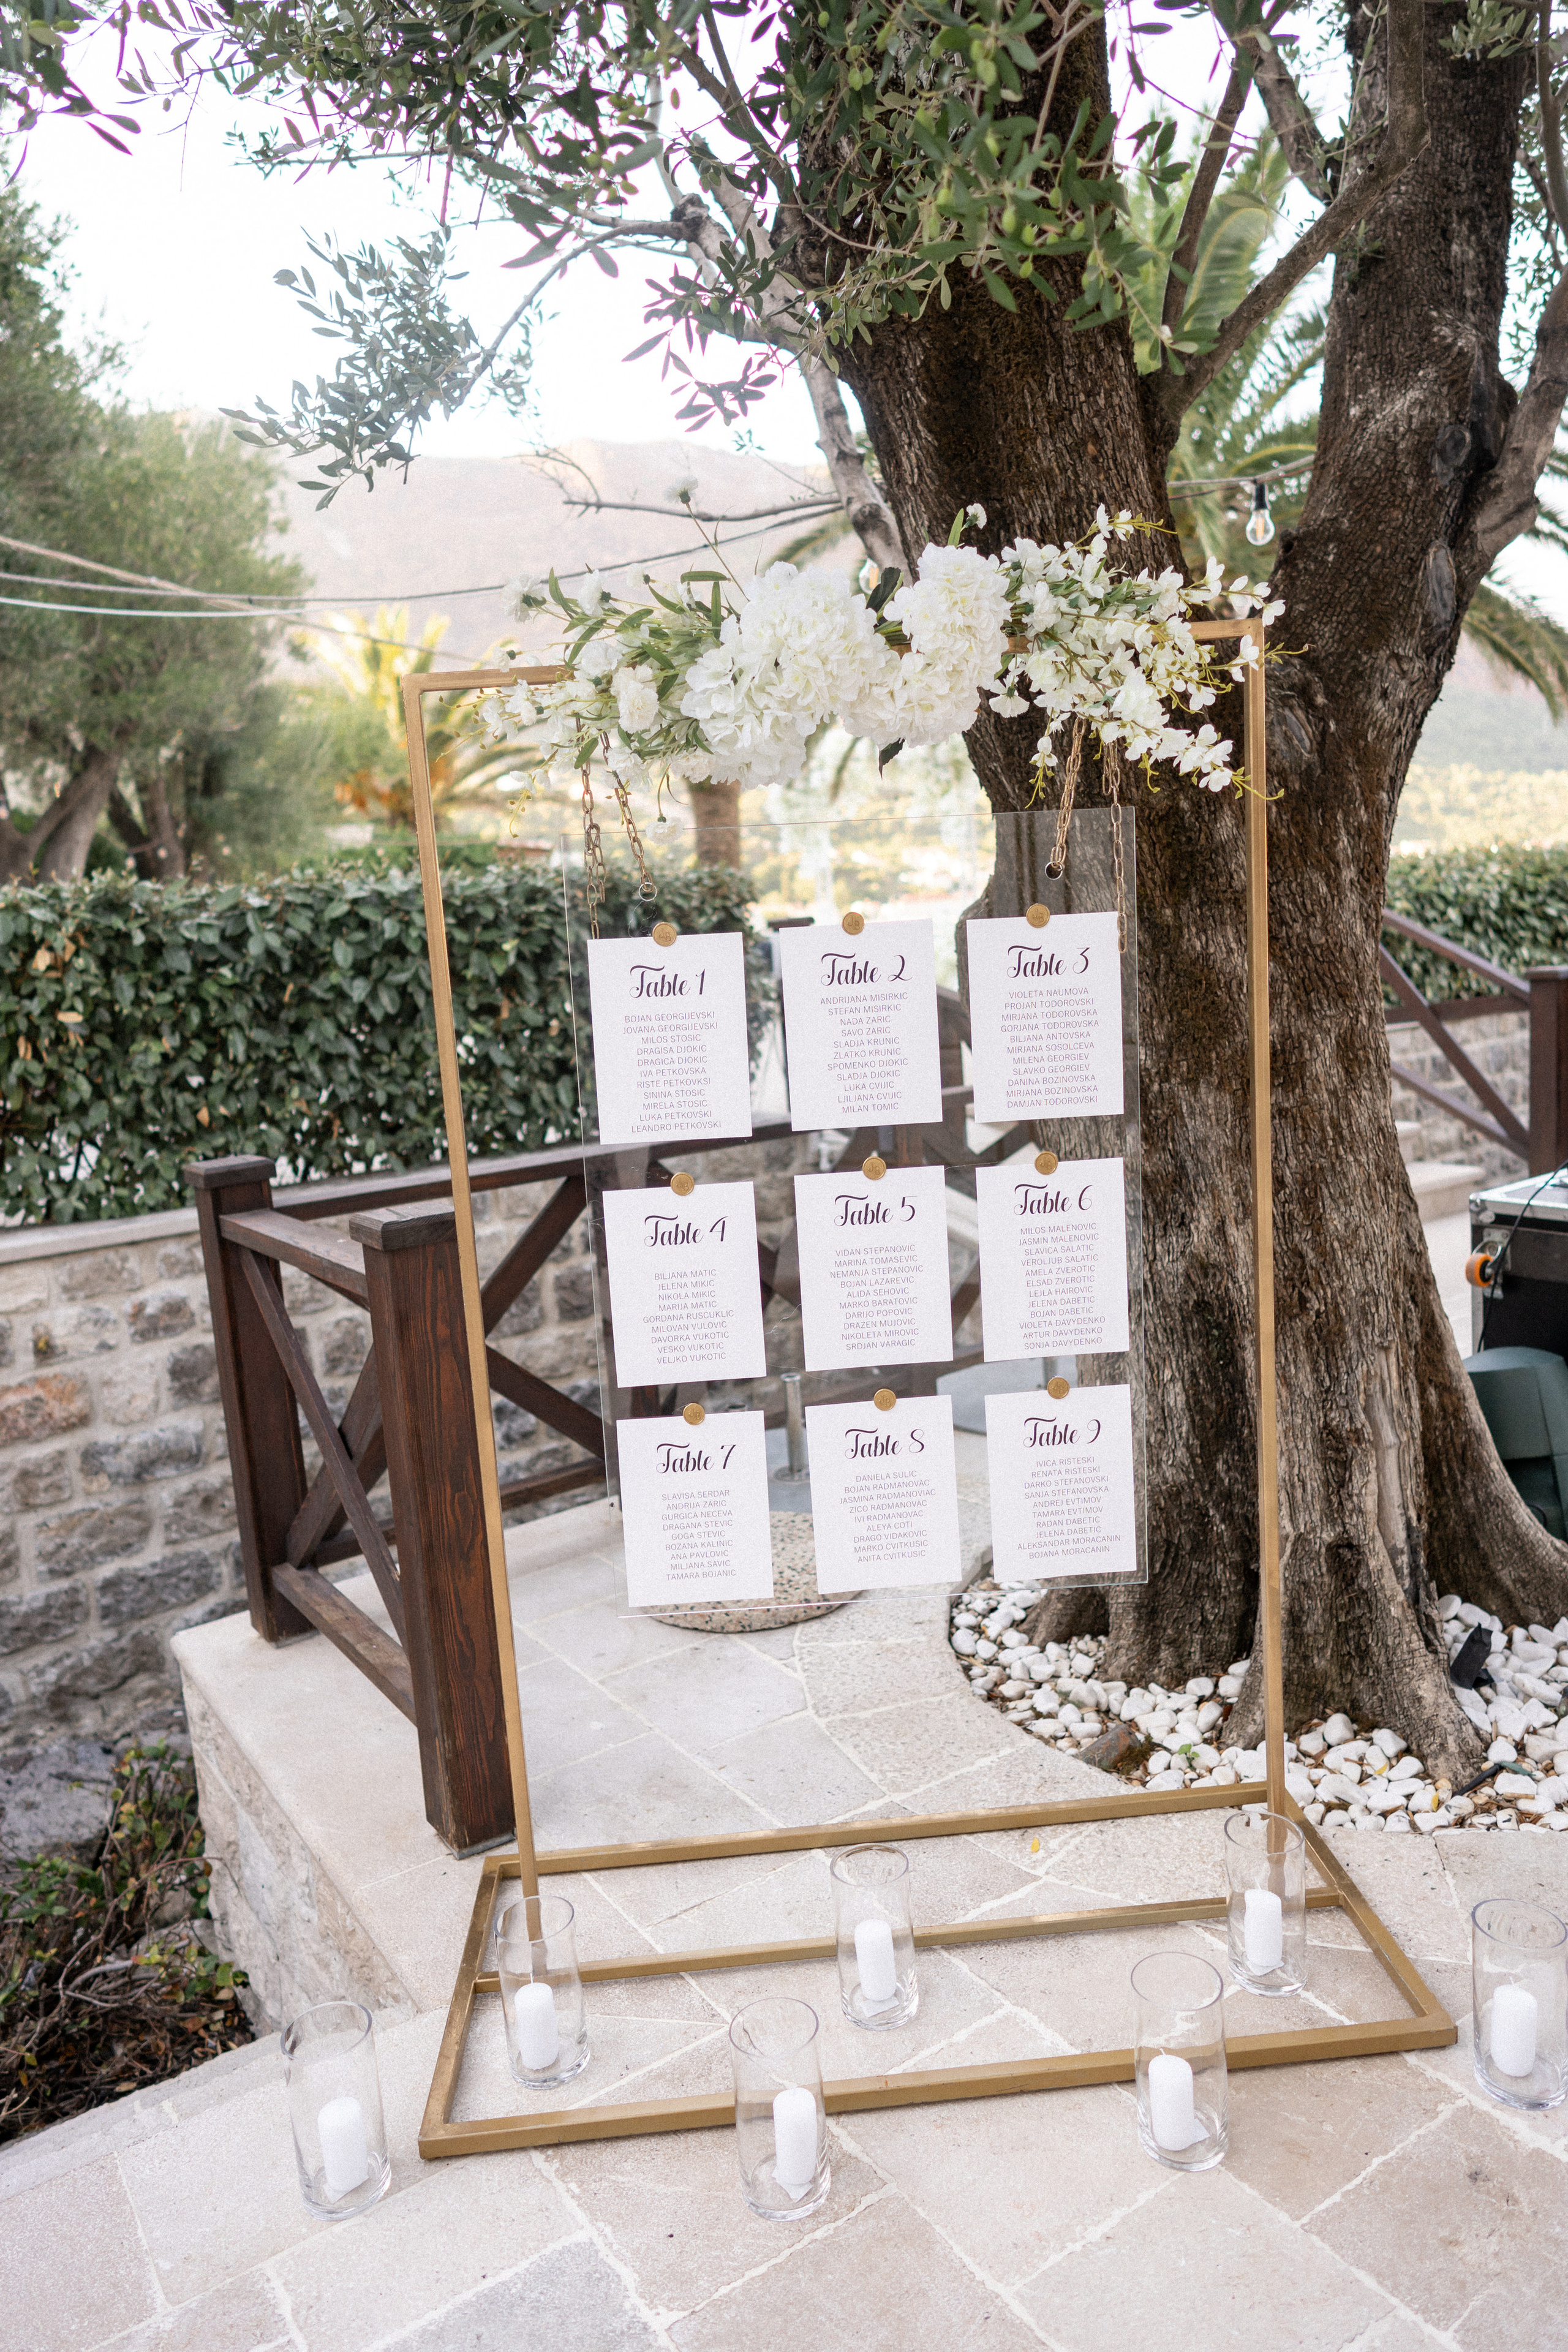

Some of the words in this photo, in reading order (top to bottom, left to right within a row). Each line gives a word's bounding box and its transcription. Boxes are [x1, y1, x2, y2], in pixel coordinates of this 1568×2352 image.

[1007, 946, 1066, 978] Table
[1073, 948, 1090, 973] 3
[821, 953, 881, 986] Table
[888, 956, 912, 981] 2
[630, 965, 690, 998] Table
[696, 969, 704, 994] 1
[820, 995, 867, 1005] ANDRIJANA
[870, 992, 908, 1001] MISIRKIC
[1008, 990, 1044, 998] VIOLETA
[1046, 987, 1088, 996] NAUMOVA
[827, 1006, 860, 1016] STEFAN
[863, 1003, 901, 1012] MISIRKIC
[1005, 1001, 1036, 1010] PROJAN
[1039, 998, 1093, 1008] TODOROVSKI
[624, 1014, 652, 1023] BOJAN
[654, 1011, 714, 1021] GEORGIJEVSKI
[840, 1017, 863, 1025] NADA
[865, 1015, 891, 1024] ZARIC
[623, 1025, 655, 1034] JOVANA
[657, 1022, 717, 1032] GEORGIJEVSKI
[841, 1028, 863, 1036] SAVO
[865, 1026, 890, 1035] ZARIC
[1000, 1023, 1039, 1032] GORJANA
[1041, 1019, 1099, 1029] TODOROVSKA
[636, 1046, 674, 1055] DRAGISA
[676, 1044, 706, 1053] DJOKIC
[637, 1057, 674, 1066] DRAGICA
[677, 1055, 707, 1064] DJOKIC
[1012, 1055, 1044, 1064] MILENA
[1047, 1052, 1089, 1062] GEORGIEV
[827, 1060, 875, 1071] SPOMENKO
[878, 1058, 908, 1067] DJOKIC
[1012, 1066, 1046, 1075] SLAVKO
[1047, 1063, 1090, 1073] GEORGIEV
[837, 1072, 867, 1081] SLADJA
[870, 1069, 900, 1079] DJOKIC
[1008, 1077, 1039, 1087] DANINA
[1042, 1074, 1095, 1084] BOZINOVSKA
[663, 1077, 710, 1087] PETKOVKSI
[643, 1090, 672, 1099] SININA
[674, 1088, 705, 1097] STOSIC
[837, 1093, 874, 1102] LJILJANA
[876, 1091, 902, 1099] CVIJIC
[1006, 1088, 1042, 1097] MIRJANA
[1044, 1085, 1098, 1095] BOZINOVSKA
[643, 1101, 674, 1110] MIRELA
[677, 1099, 707, 1108] STOSIC
[842, 1104, 869, 1113] MILAN
[871, 1102, 899, 1111] TOMIC
[1007, 1099, 1041, 1108] DAMJAN
[1044, 1095, 1097, 1106] TODOROVSKI
[639, 1113, 662, 1121] LUKA
[665, 1110, 712, 1120] PETKOVSKI
[1014, 1184, 1071, 1215] Table
[1079, 1185, 1092, 1210] 6
[835, 1195, 893, 1226] Table
[900, 1196, 916, 1221] 5
[644, 1215, 703, 1246] Table
[710, 1216, 728, 1242] 4
[1020, 1226, 1046, 1235] MILOS
[1048, 1222, 1096, 1232] MALENOVIC
[1024, 1246, 1058, 1256] SLAVICA
[1060, 1243, 1093, 1253] SALATIC
[654, 1271, 688, 1280] BILJANA
[690, 1268, 716, 1277] MATIC
[658, 1281, 688, 1291] JELENA
[690, 1279, 714, 1287] MIKIC
[840, 1279, 866, 1288] BOJAN
[869, 1276, 914, 1286] LAZAREVIC
[658, 1292, 689, 1300] NIKOLA
[846, 1289, 870, 1298] ALIDA
[873, 1287, 909, 1296] SEHOVIC
[1029, 1289, 1052, 1297] LEJLA
[1055, 1285, 1093, 1295] HAIROVIC
[658, 1302, 688, 1311] MARIJA
[839, 1300, 869, 1309] MARKO
[872, 1297, 918, 1306] BARATOVIC
[1028, 1298, 1057, 1308] JELENA
[1060, 1295, 1095, 1305] DABETIC
[845, 1310, 874, 1319] DARIJO
[876, 1307, 913, 1316] POPOVIC
[1030, 1310, 1055, 1318] BOJAN
[1058, 1306, 1093, 1316] DABETIC
[652, 1324, 688, 1333] MILOVAN
[691, 1321, 726, 1330] VULOVIC
[843, 1321, 876, 1330] DRAZEN
[879, 1317, 915, 1327] MUJOVIC
[1019, 1320, 1052, 1329] VIOLETA
[1055, 1316, 1105, 1326] DAVYDENKO
[650, 1333, 690, 1344] DAVORKA
[692, 1330, 729, 1340] VUKOTIC
[841, 1331, 881, 1340] NIKOLETA
[884, 1327, 919, 1336] MIROVIC
[1022, 1330, 1050, 1339] ARTUR
[1052, 1326, 1102, 1336] DAVYDENKO
[846, 1341, 877, 1351] SRDJAN
[880, 1338, 915, 1348] VARAGIC
[1023, 1341, 1050, 1349] SONJA
[1052, 1336, 1102, 1347] DAVYDENKO
[657, 1355, 687, 1364] VELJKO
[689, 1352, 726, 1361] VUKOTIC
[1023, 1417, 1080, 1447] Table
[1087, 1420, 1100, 1443] 9
[845, 1428, 902, 1458] Table
[910, 1430, 924, 1453] 8
[657, 1443, 714, 1473] Table
[721, 1445, 736, 1469] 7
[1059, 1456, 1094, 1465] RISTESKI
[856, 1472, 891, 1482] DANIELA
[892, 1470, 916, 1479] SULIC
[1031, 1469, 1062, 1478] RENATA
[1065, 1466, 1099, 1475] RISTESKI
[844, 1485, 870, 1493] BOJAN
[872, 1479, 929, 1490] RADMANOVAC
[1024, 1490, 1049, 1499] SANJA
[1051, 1485, 1109, 1496] STEFANOVSKA
[840, 1494, 873, 1504] JASMINA
[876, 1488, 935, 1500] RADMANOVIAC
[1033, 1499, 1063, 1508] ANDREJ
[1066, 1496, 1101, 1505] EVTIMOV
[666, 1501, 700, 1510] ANDRIJA
[870, 1499, 927, 1511] RADMANOVAC
[661, 1512, 698, 1521] GURGICA
[700, 1509, 733, 1518] NECEVA
[867, 1510, 923, 1521] RADMANOVAC
[1036, 1519, 1063, 1528] RADAN
[1066, 1515, 1099, 1525] DABETIC
[696, 1529, 725, 1539] STEVIC
[853, 1534, 881, 1543] DRAGO
[883, 1529, 927, 1540] VIDAKOVIC
[665, 1542, 698, 1550] BOZANA
[701, 1539, 733, 1548] KALINIC
[1017, 1539, 1069, 1550] ALEKSANDAR
[1072, 1534, 1120, 1544] MORACANIN
[690, 1550, 728, 1558] PAVLOVIC
[1029, 1549, 1059, 1559] BOJANA
[1061, 1545, 1109, 1555] MORACANIN
[670, 1561, 704, 1570] MILJANA
[666, 1572, 699, 1580] TAMARA
[702, 1569, 736, 1578] BOJANIC
